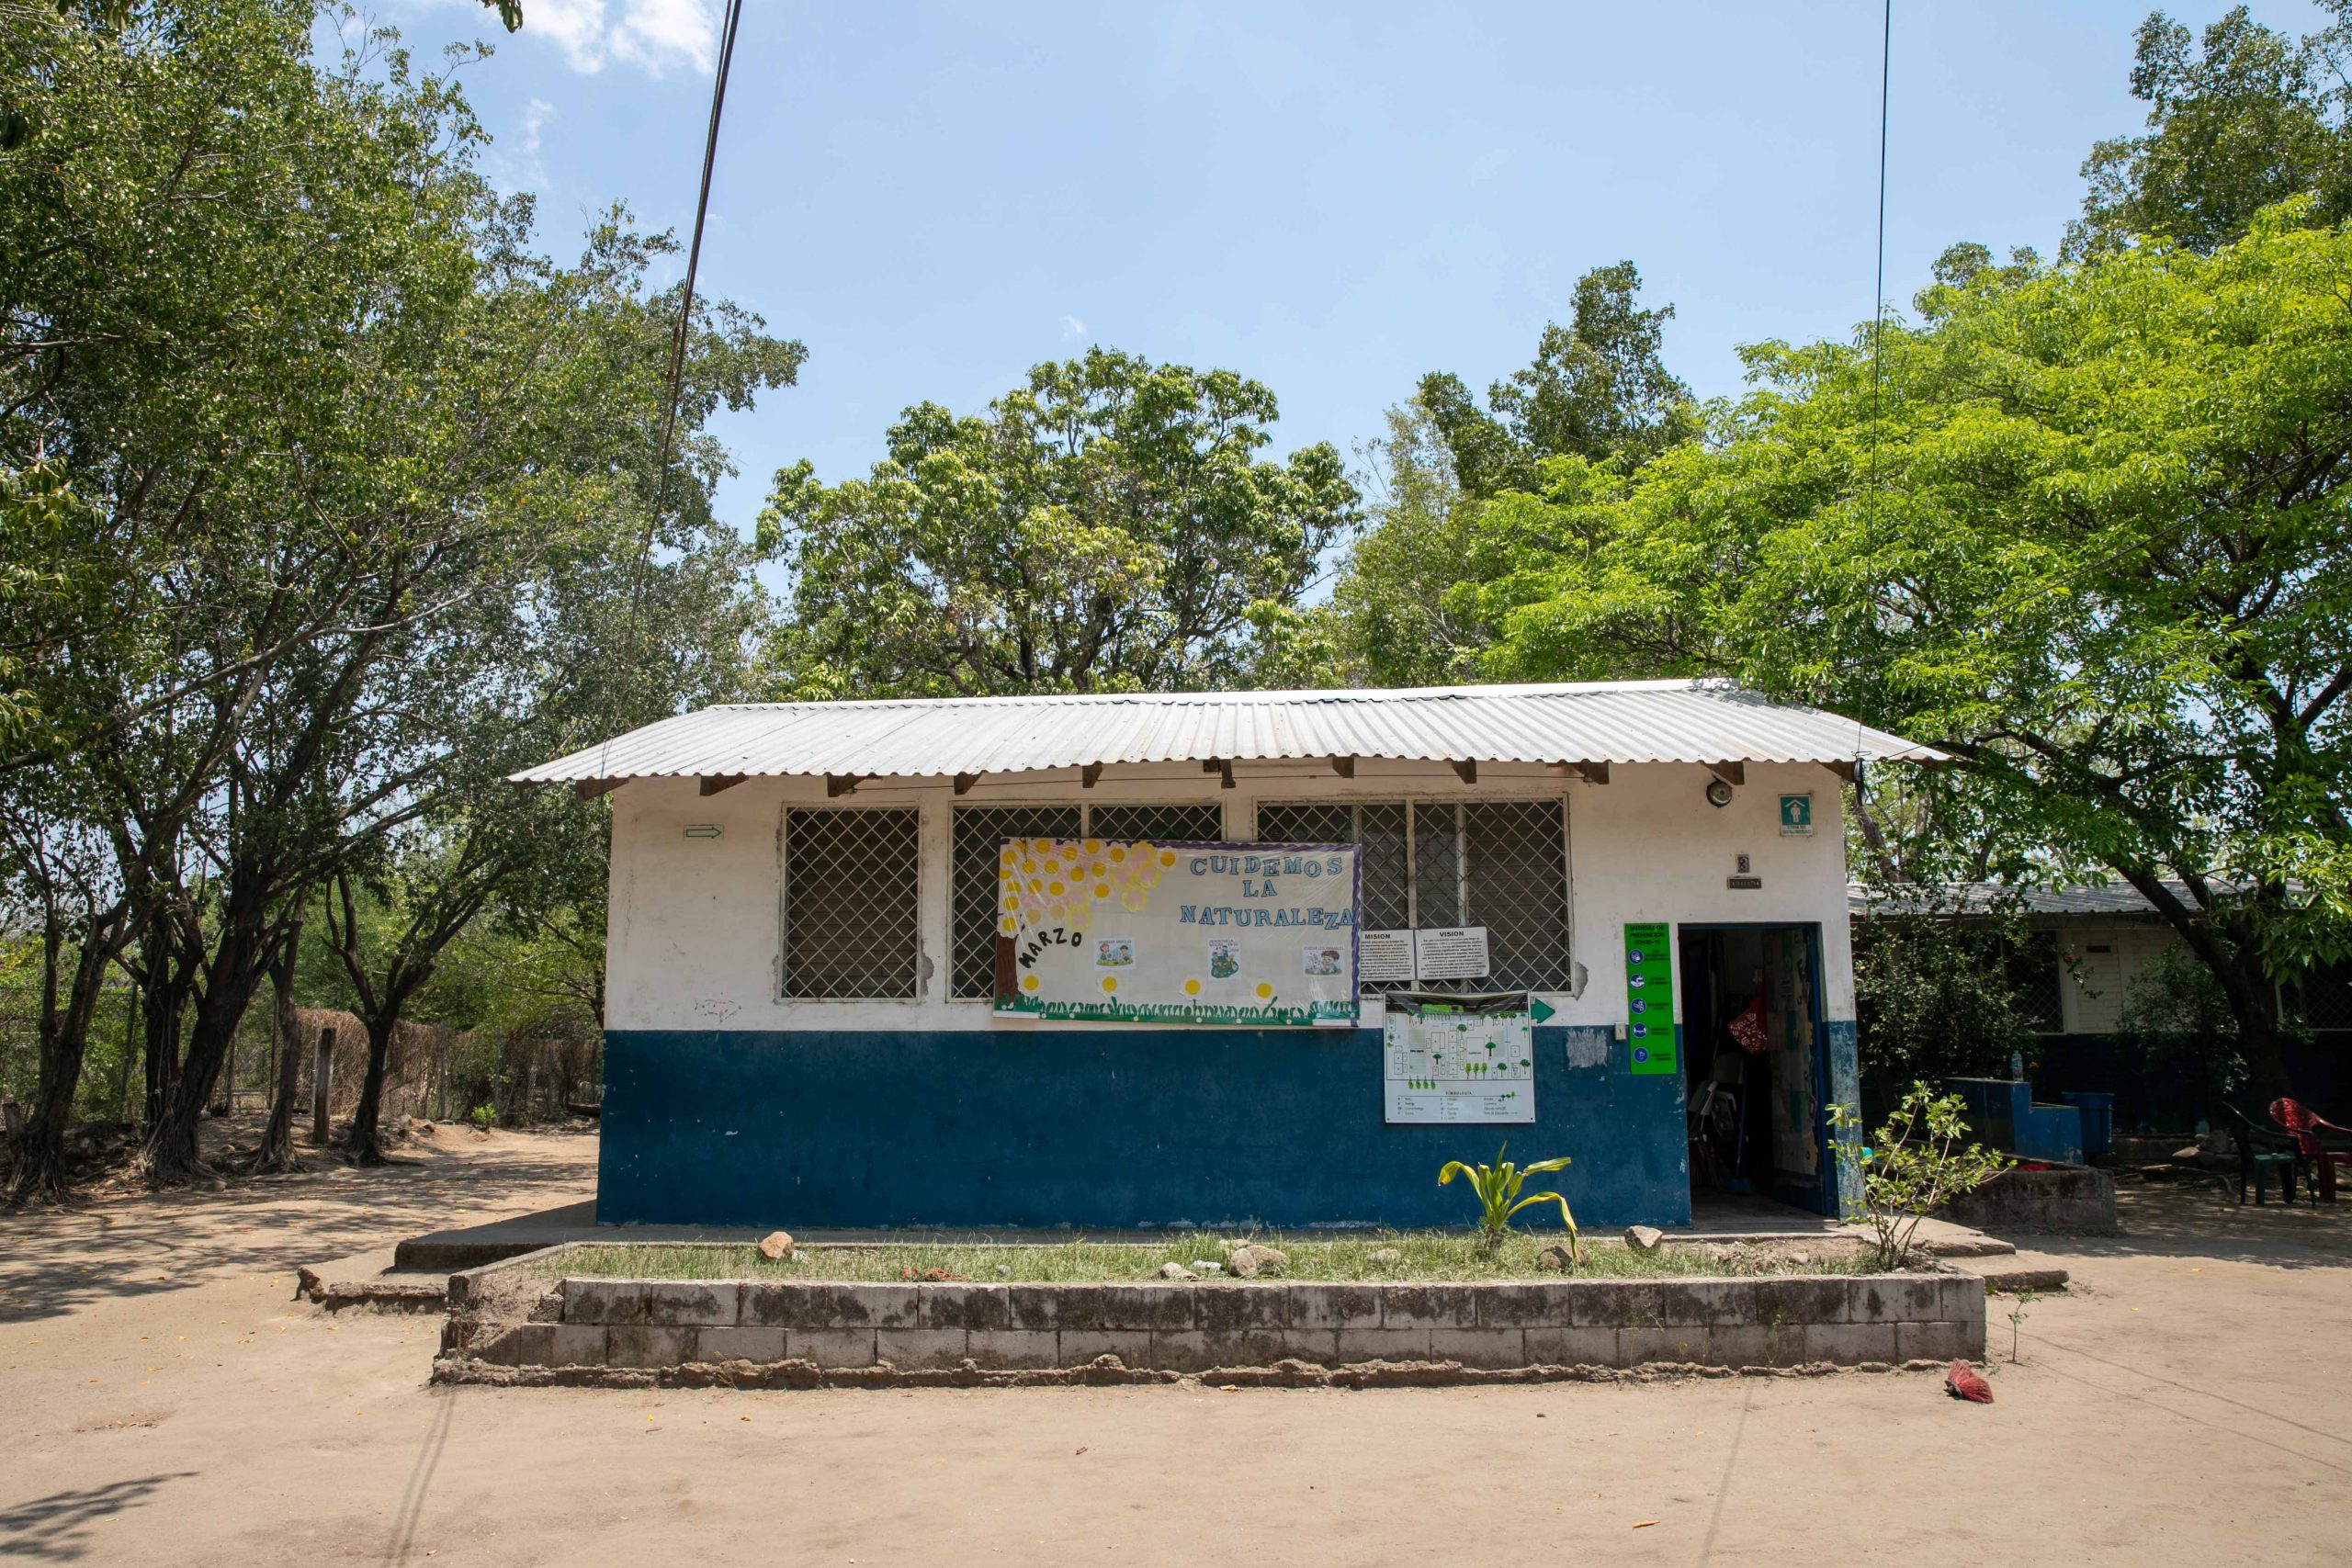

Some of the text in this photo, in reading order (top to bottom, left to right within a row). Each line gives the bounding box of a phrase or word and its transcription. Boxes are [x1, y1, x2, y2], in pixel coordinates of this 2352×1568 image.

[1190, 856, 1342, 877] CUIDEMOS
[1242, 879, 1277, 897] LA
[1180, 905, 1355, 930] NATURALEZA
[1018, 928, 1082, 969] MARZO
